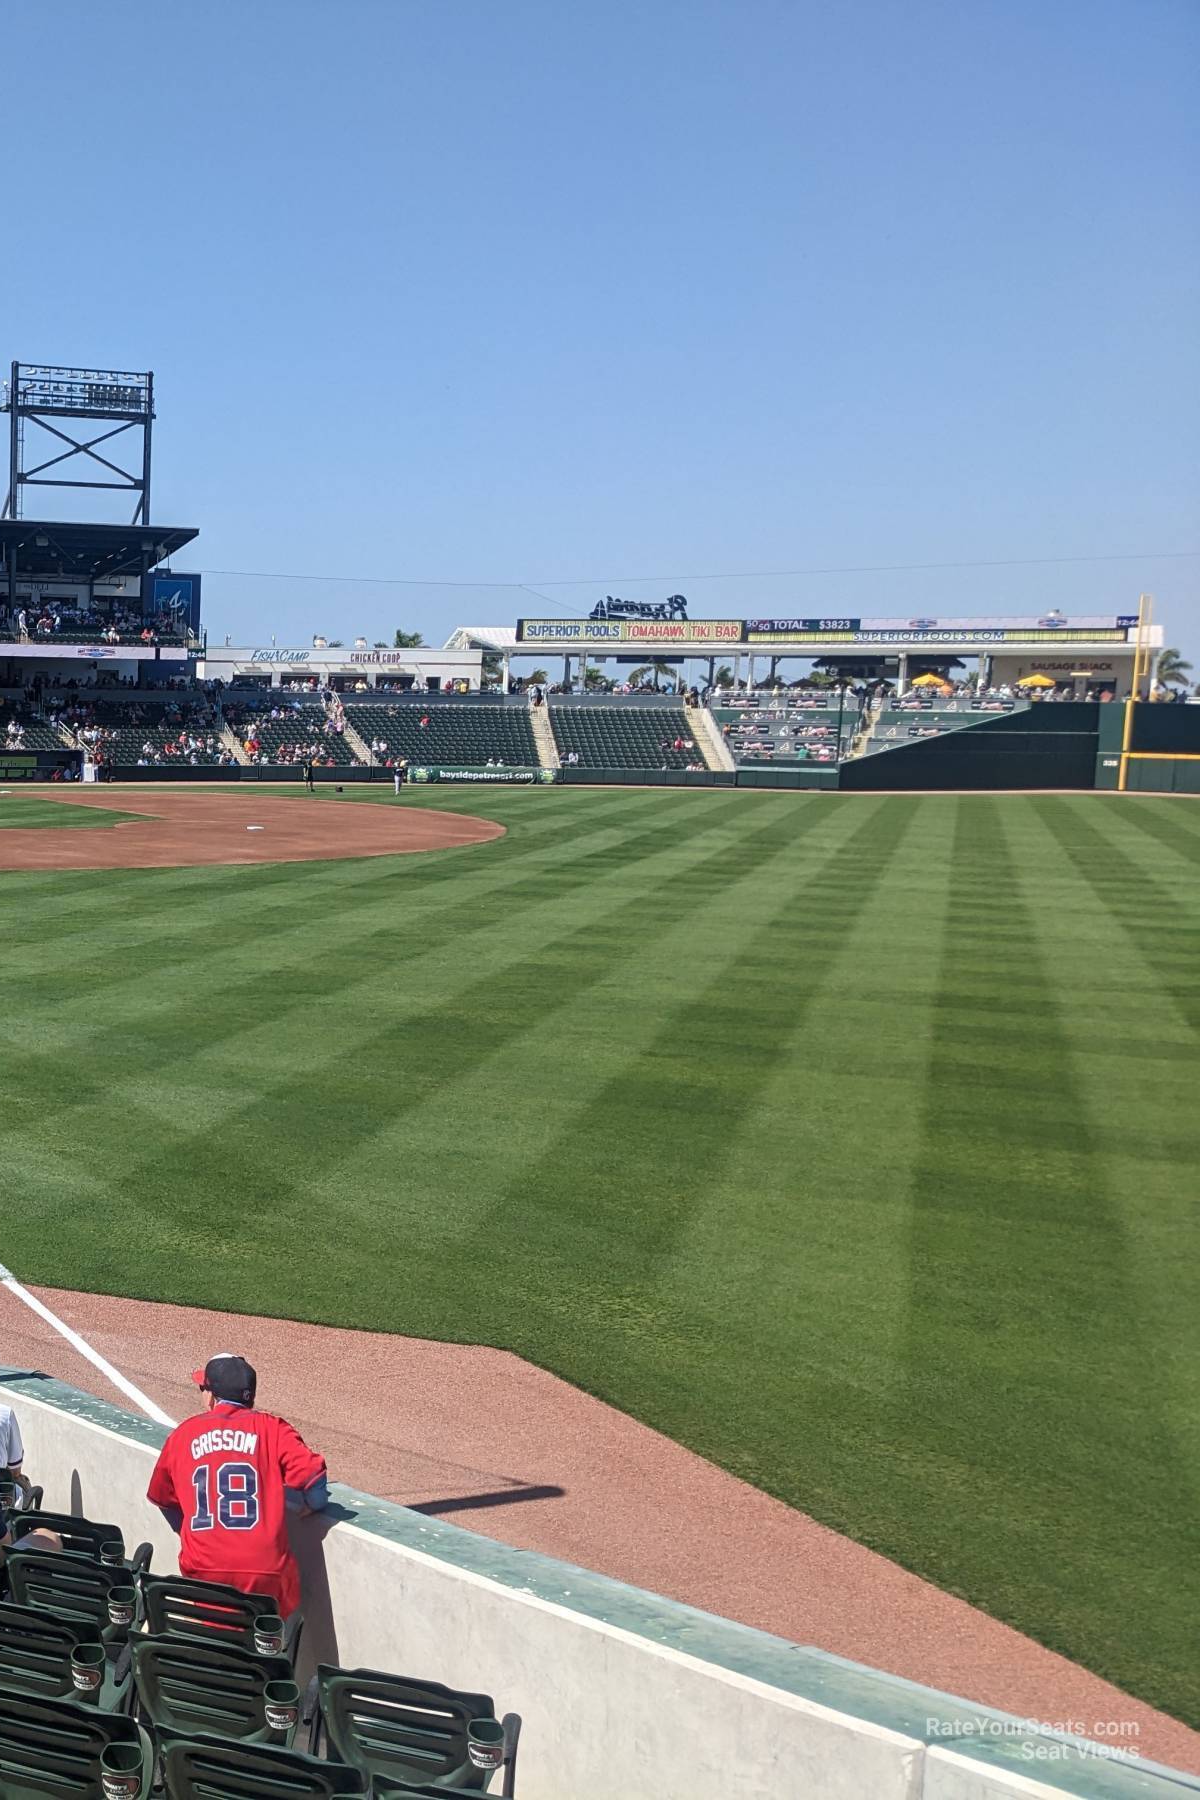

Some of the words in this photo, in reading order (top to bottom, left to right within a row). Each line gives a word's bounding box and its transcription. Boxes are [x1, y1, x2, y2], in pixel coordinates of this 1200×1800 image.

[773, 620, 809, 630] TOTAL:
[818, 620, 851, 630] $3823
[526, 625, 581, 638] SUPERIOR
[584, 625, 620, 638] POOLS
[626, 625, 686, 638] TOMAHAWK
[691, 625, 711, 638] TIKI
[715, 625, 739, 638] BAR
[853, 631, 1005, 642] SUPERIORPOOLS.COM
[350, 652, 381, 663] CHICKEN
[382, 652, 401, 664] COOP
[1030, 662, 1076, 671] SAUSAGE
[1079, 662, 1113, 671] SHACK
[439, 769, 534, 780] baysidepetresort.com
[190, 1429, 258, 1460] GRISSOM
[190, 1462, 259, 1531] 18
